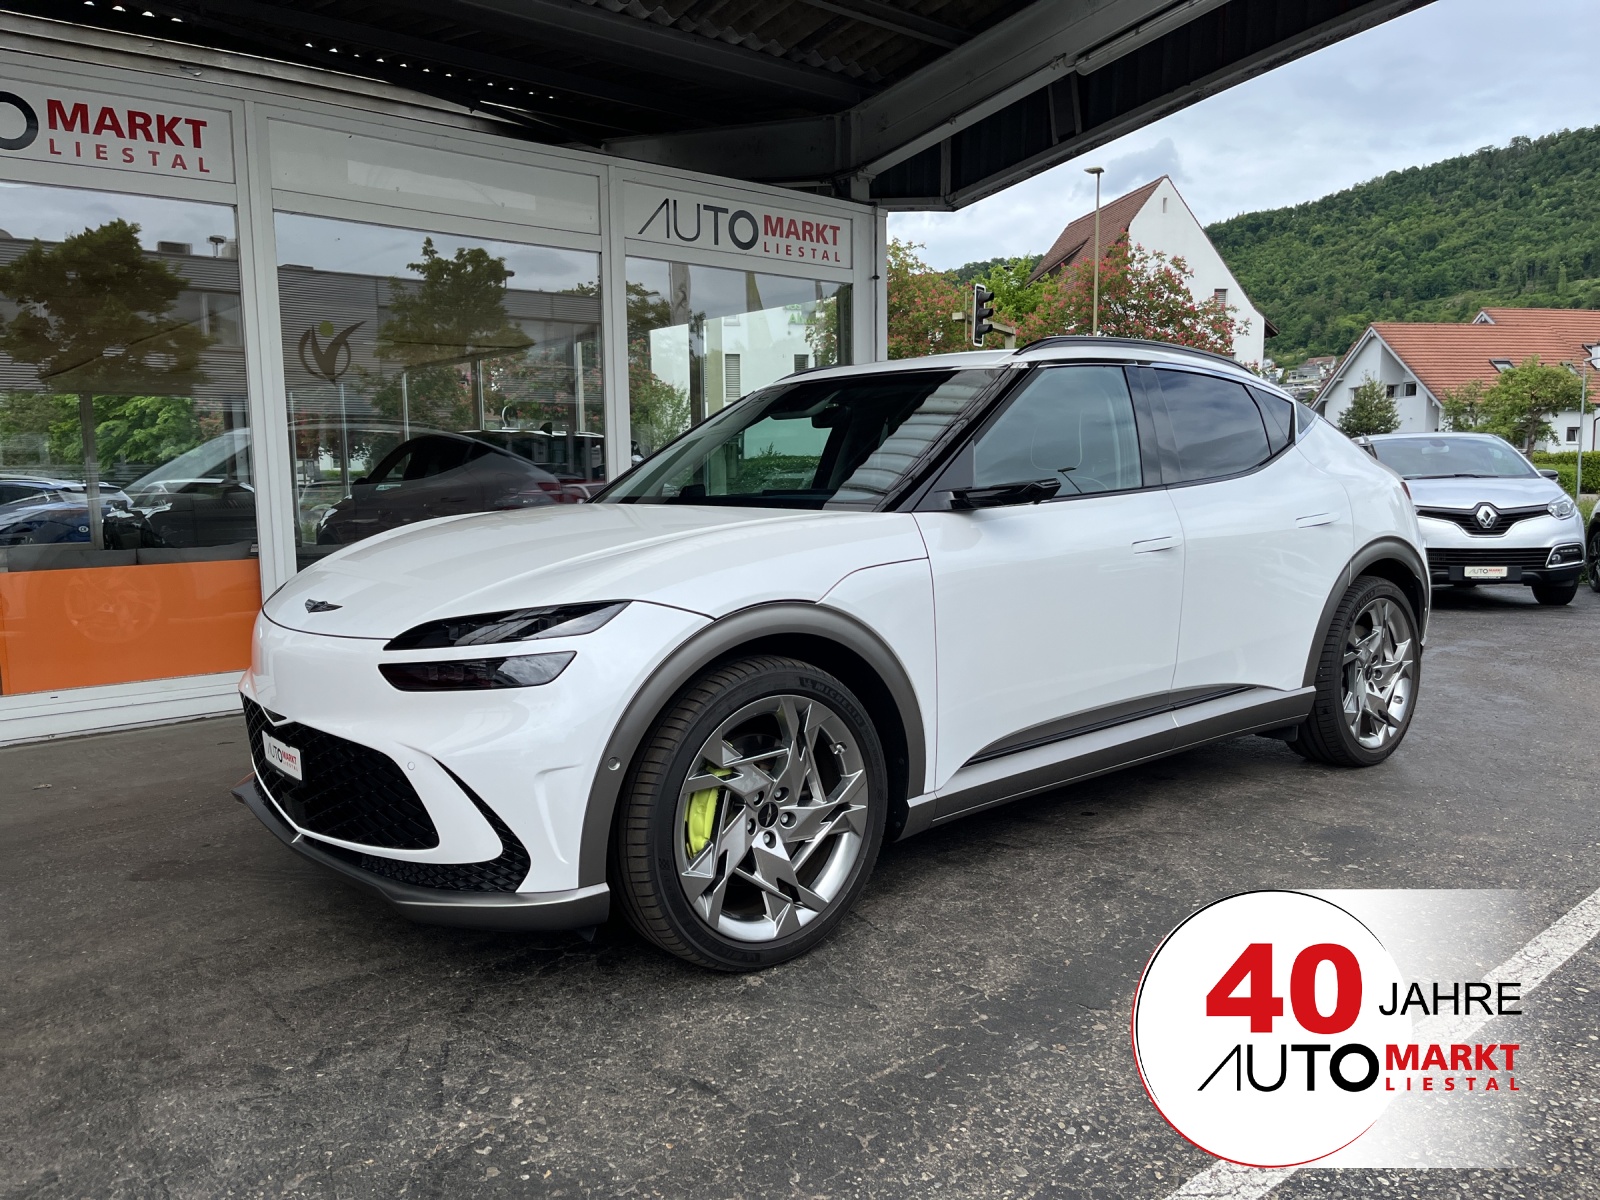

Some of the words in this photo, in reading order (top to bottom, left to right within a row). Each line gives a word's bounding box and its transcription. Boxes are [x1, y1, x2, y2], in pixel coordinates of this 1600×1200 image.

[46, 99, 208, 149] MARKT
[49, 138, 210, 173] LIESTAL
[637, 198, 759, 251] AUTO
[763, 214, 841, 246] MARKT
[763, 241, 841, 263] LIESTAL
